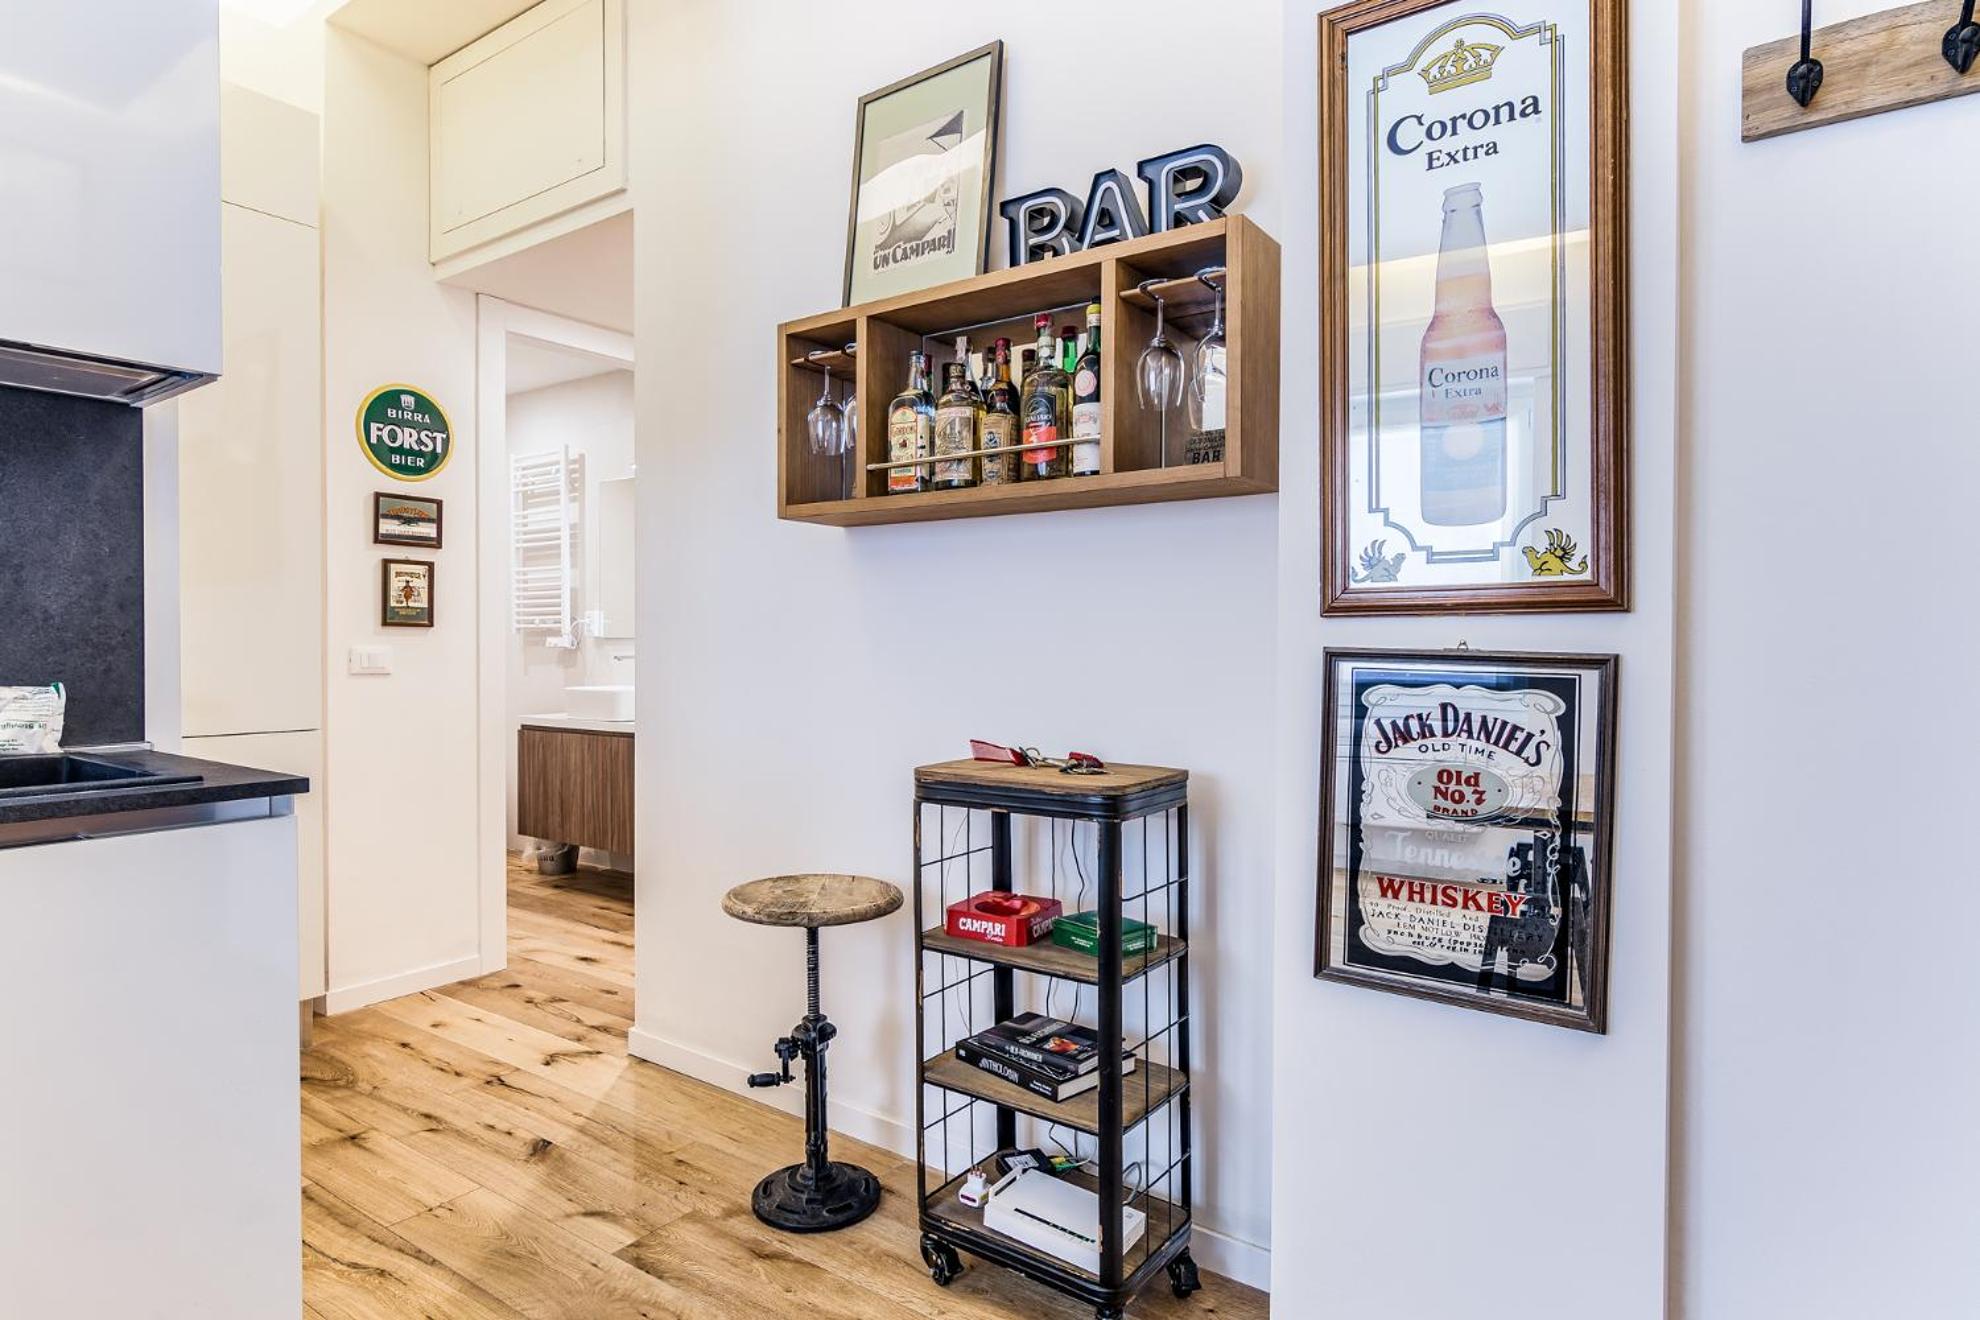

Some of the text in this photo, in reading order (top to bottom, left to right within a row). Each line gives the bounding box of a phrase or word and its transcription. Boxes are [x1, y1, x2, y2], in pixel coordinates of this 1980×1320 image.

[1387, 94, 1542, 156] Corona
[1426, 141, 1499, 171] Extra
[1000, 144, 1242, 269] BAR
[1428, 366, 1499, 388] Corona
[387, 408, 431, 425] BIRRA
[370, 422, 446, 454] FORST
[391, 454, 425, 468] BIER
[1374, 702, 1551, 767] JACK DANIEL'S
[1418, 743, 1497, 761] OLD TIME
[1436, 768, 1482, 788] Old
[1432, 804, 1479, 818] BRAND
[1376, 876, 1528, 919] WHISKEY
[959, 917, 1006, 937] CAMPARI
[1371, 908, 1401, 920] JACK
[1410, 914, 1456, 929] DANIEL
